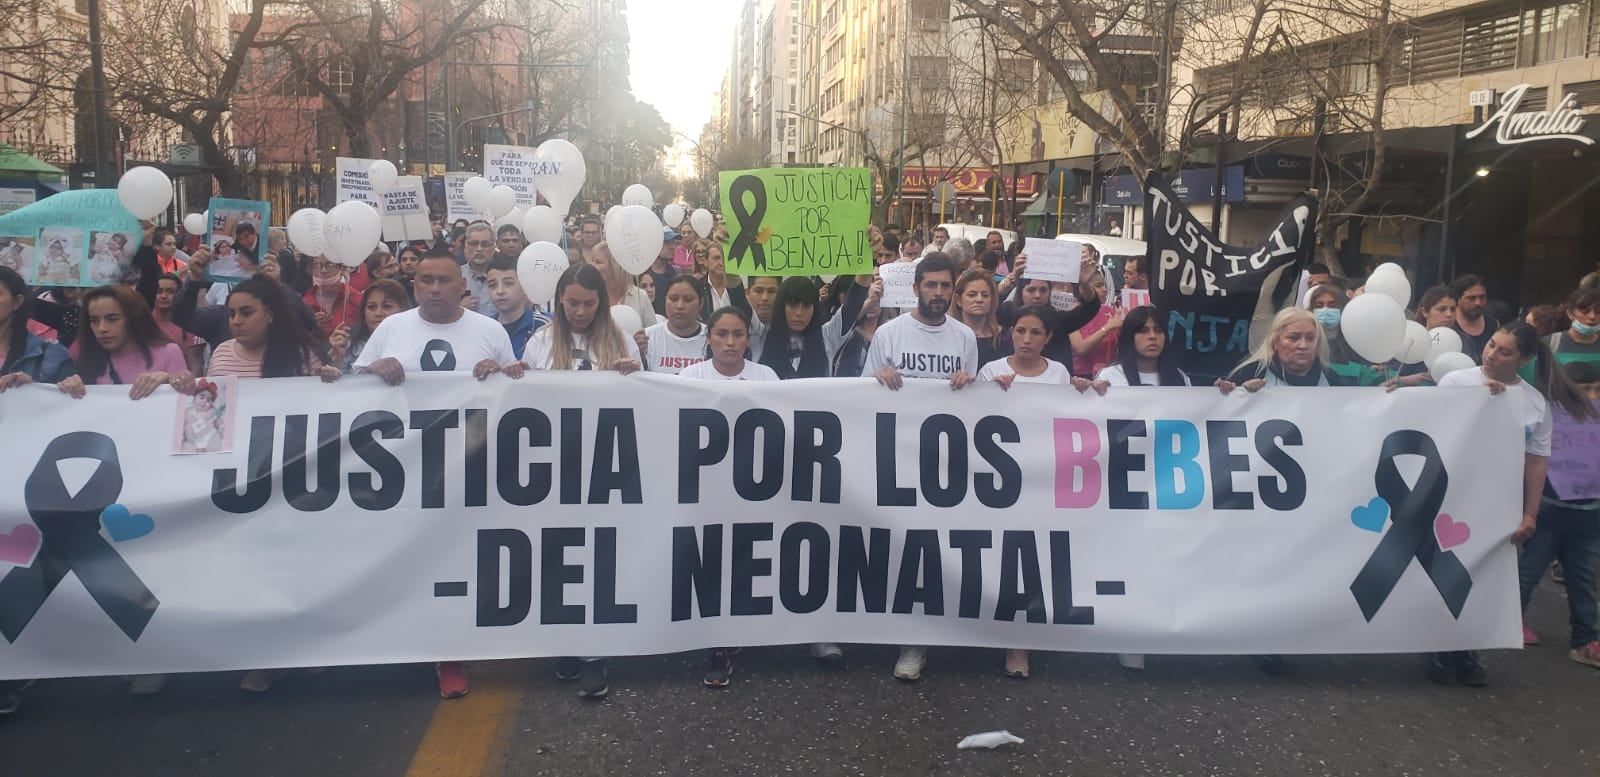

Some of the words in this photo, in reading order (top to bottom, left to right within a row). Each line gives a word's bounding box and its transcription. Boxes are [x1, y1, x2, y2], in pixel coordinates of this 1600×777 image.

[1466, 83, 1595, 144] Amalia
[343, 170, 369, 179] COMISIÓ
[500, 167, 521, 175] TODA
[501, 176, 533, 184] VERDAD
[772, 170, 869, 204] JUSTICIA
[795, 205, 831, 234] POR
[1158, 249, 1227, 297] POR
[1167, 310, 1248, 352] NJA
[899, 352, 961, 373] JUSTICIA
[211, 408, 643, 515] JUSTICIA
[678, 408, 842, 504] POR
[876, 413, 1022, 508] LOS
[1054, 416, 1306, 511] BEBES
[434, 527, 638, 627] -DEL
[671, 521, 1126, 626] NEONATAL-
